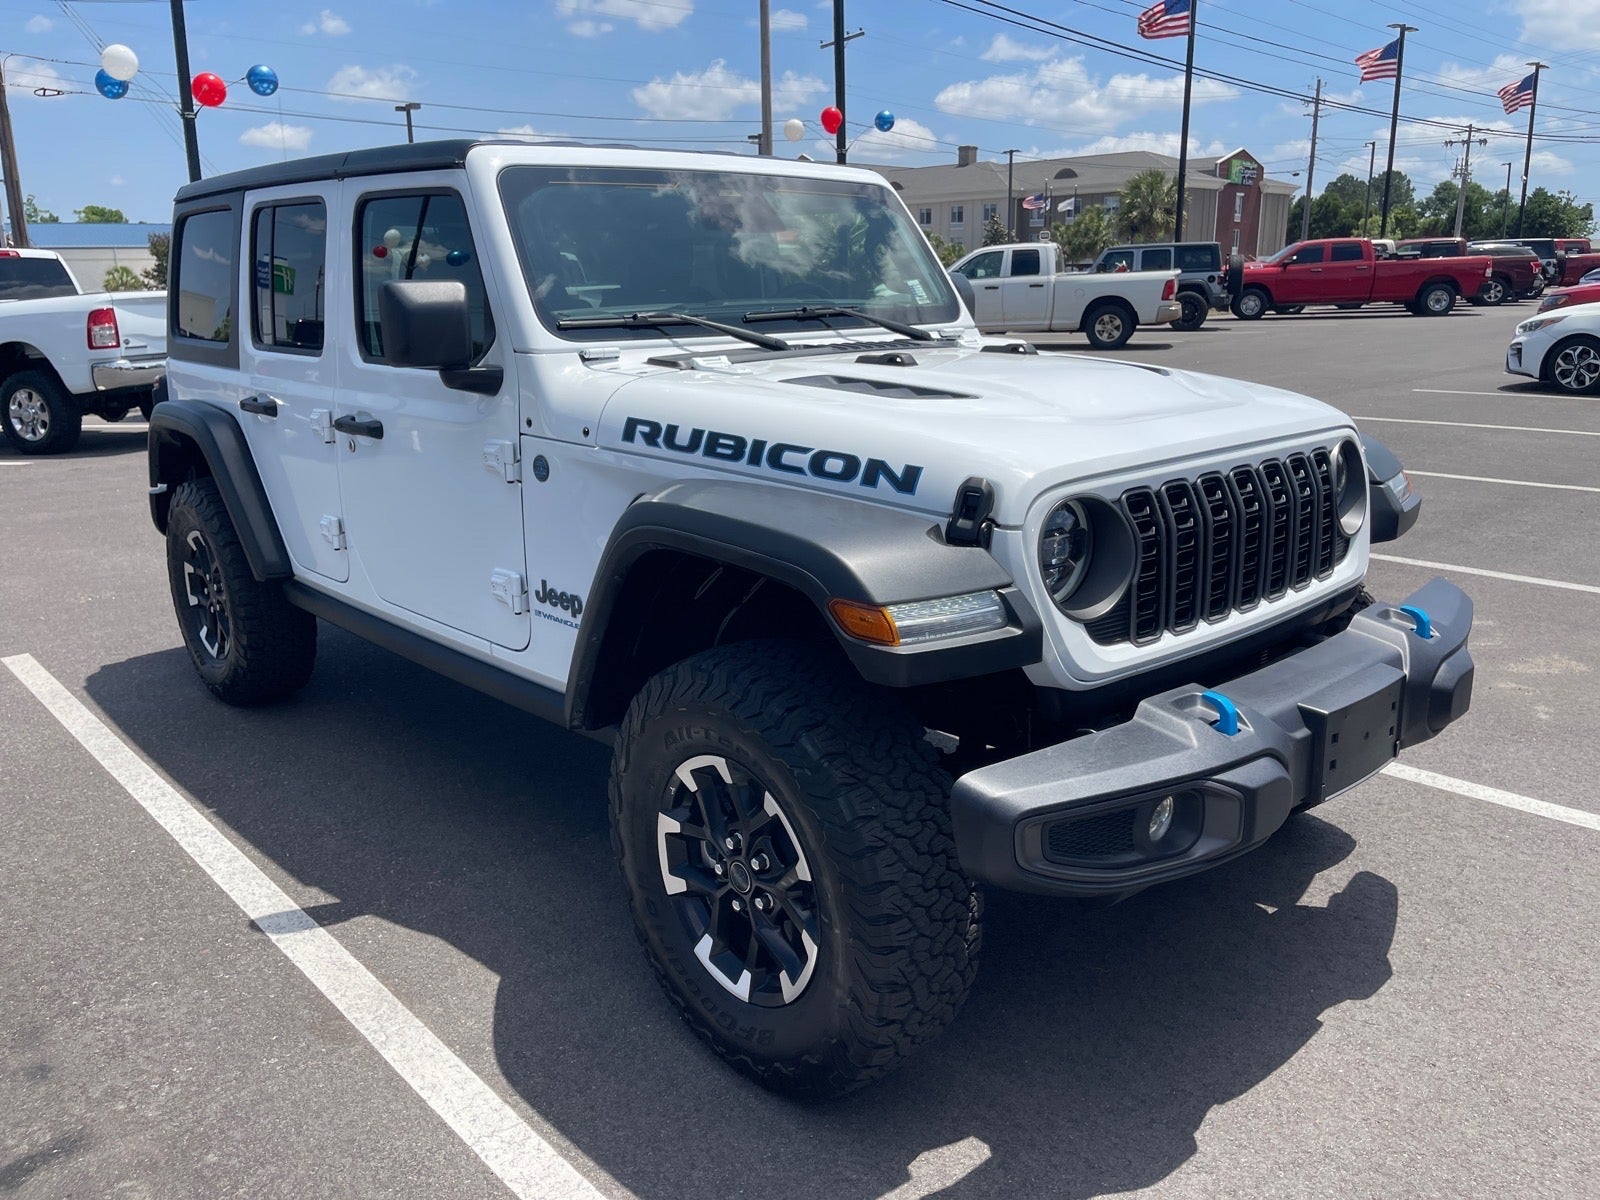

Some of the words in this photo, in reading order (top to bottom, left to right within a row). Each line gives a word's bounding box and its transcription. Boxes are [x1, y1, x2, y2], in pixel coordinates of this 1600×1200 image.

[621, 416, 924, 496] RUBICON
[534, 579, 583, 619] Jeep
[541, 610, 581, 630] WRANGLE
